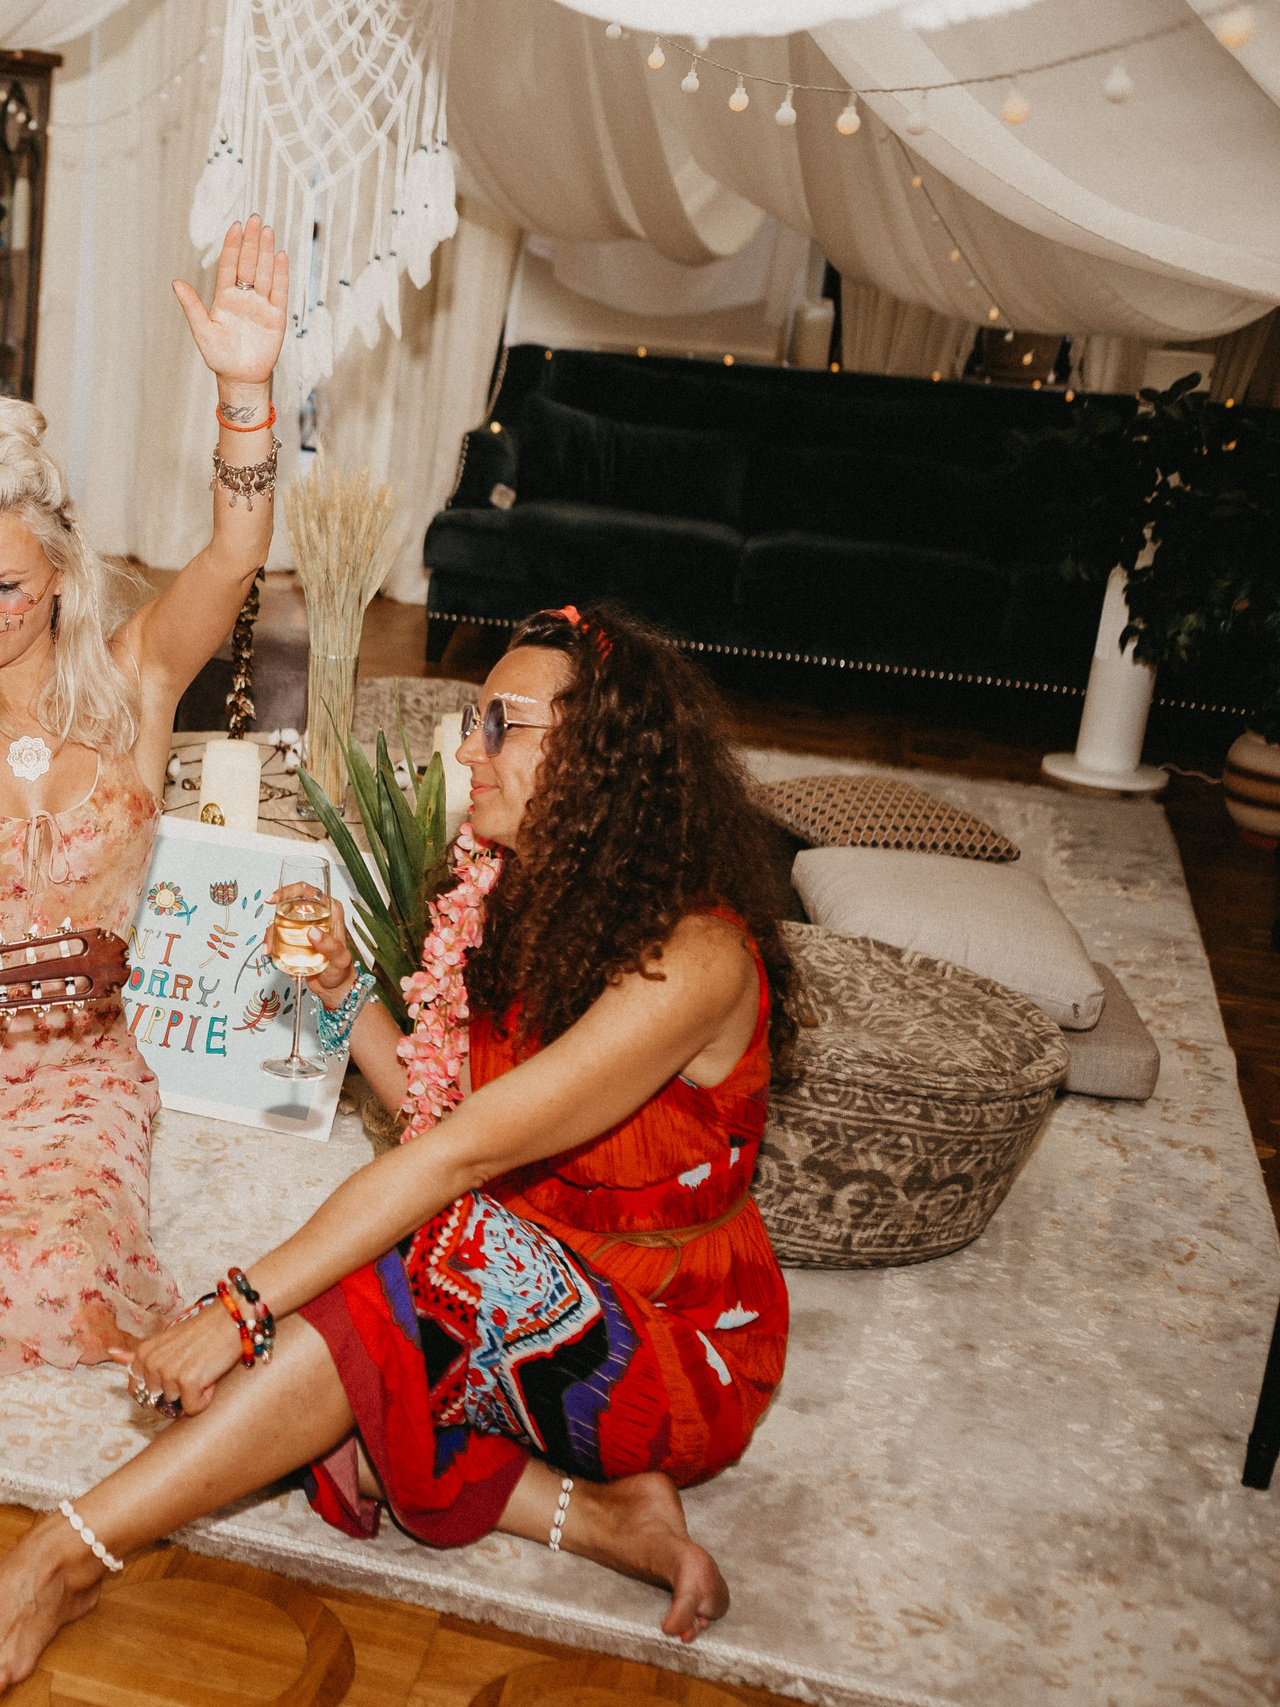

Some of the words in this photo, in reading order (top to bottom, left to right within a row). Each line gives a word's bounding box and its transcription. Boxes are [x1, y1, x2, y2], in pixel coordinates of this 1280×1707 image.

[124, 925, 181, 967] N'T
[128, 966, 221, 1008] ORRY,
[121, 996, 228, 1057] IPPIE
